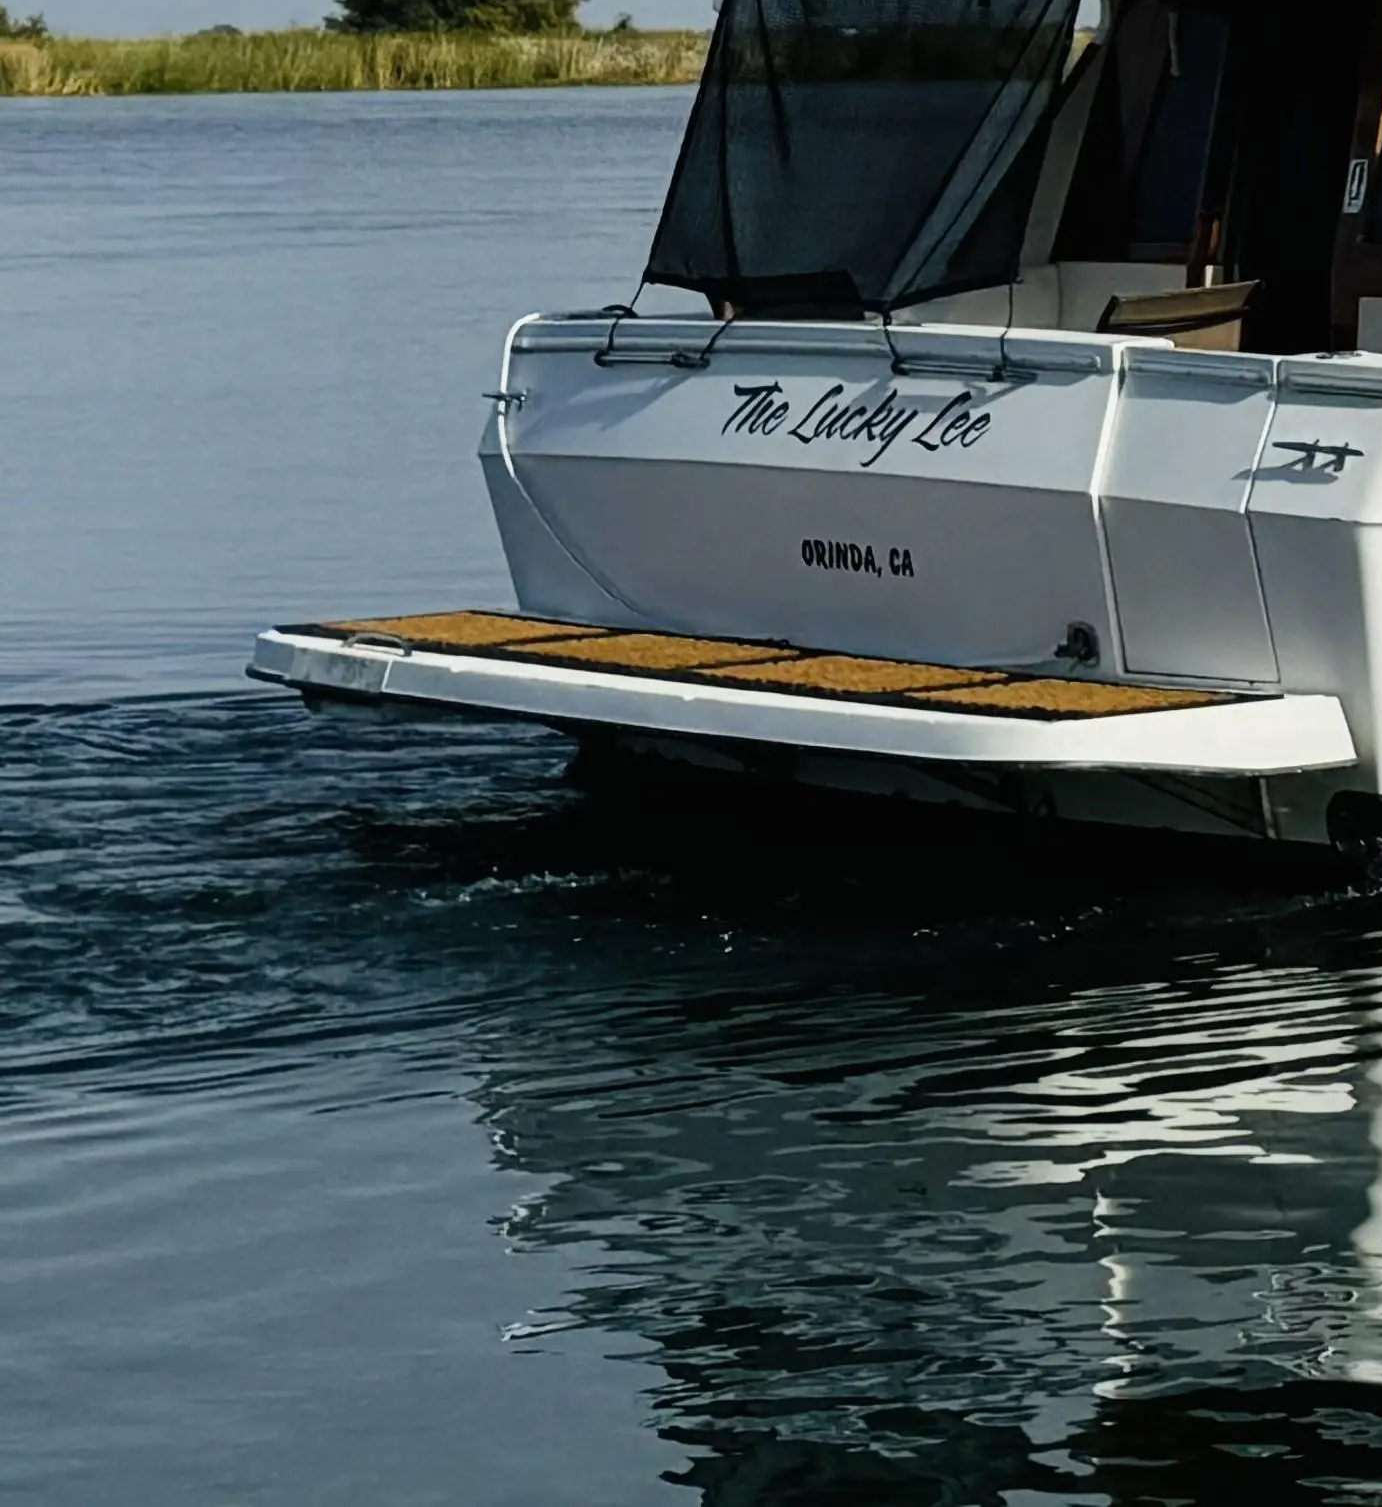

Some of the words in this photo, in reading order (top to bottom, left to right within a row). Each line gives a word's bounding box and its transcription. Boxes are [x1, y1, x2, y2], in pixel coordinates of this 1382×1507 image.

[722, 380, 790, 436] The
[787, 384, 918, 468] Lucky
[911, 391, 991, 452] Lee
[801, 539, 882, 578] ORINDA,
[889, 547, 915, 577] CA
